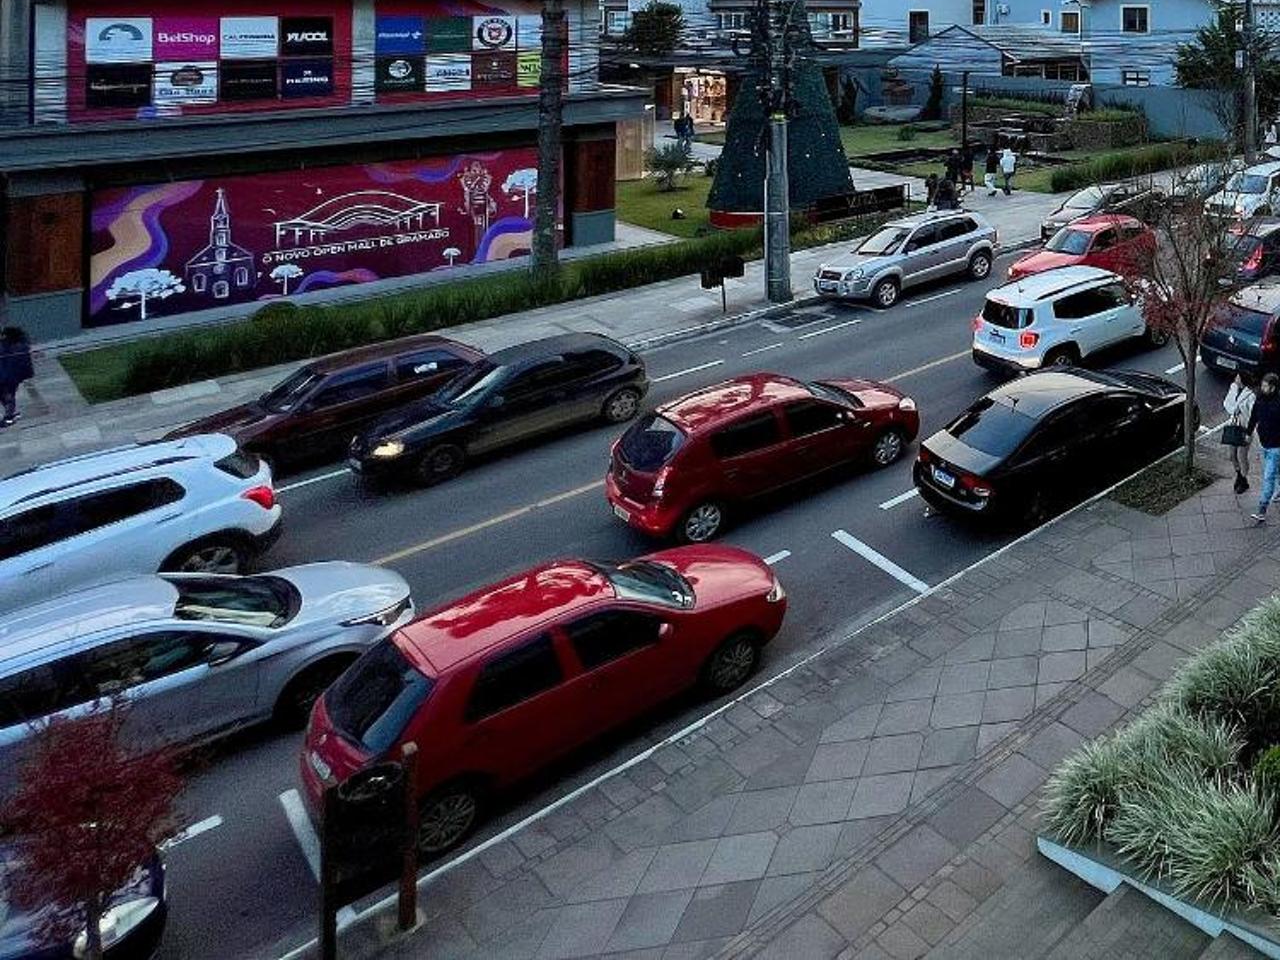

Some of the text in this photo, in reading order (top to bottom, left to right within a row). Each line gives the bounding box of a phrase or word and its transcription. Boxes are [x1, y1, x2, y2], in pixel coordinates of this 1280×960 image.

[158, 32, 216, 45] BelShop
[262, 253, 272, 264] O
[275, 249, 310, 261] NOVO
[313, 244, 345, 256] OPEN
[396, 230, 450, 244] GRAMADO
